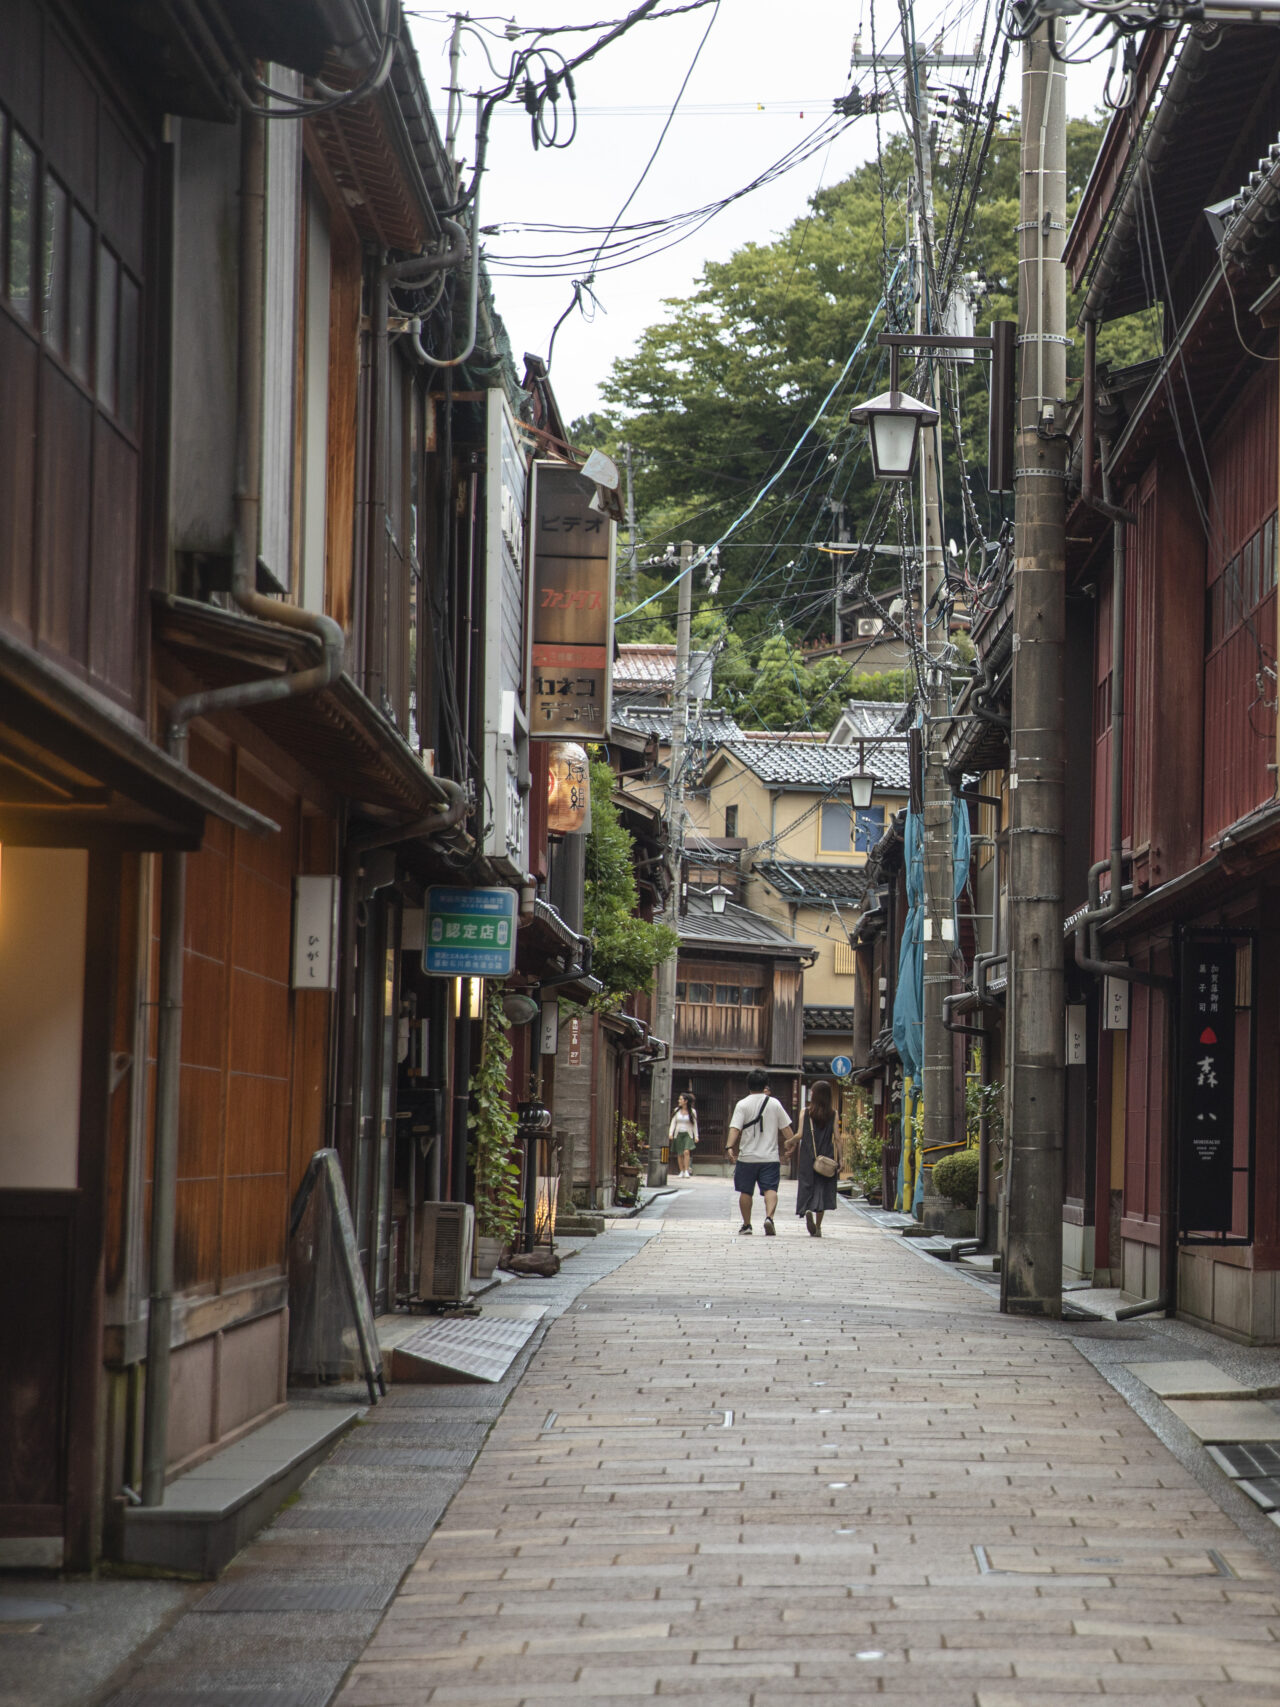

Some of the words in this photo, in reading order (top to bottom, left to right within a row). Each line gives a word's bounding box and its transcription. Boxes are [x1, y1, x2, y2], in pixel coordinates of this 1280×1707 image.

[541, 516, 603, 534] ビデオ
[535, 677, 596, 697] カネコ
[445, 923, 495, 940] 認定店
[307, 935, 320, 978] ひがし
[1114, 993, 1122, 1023] ひがし
